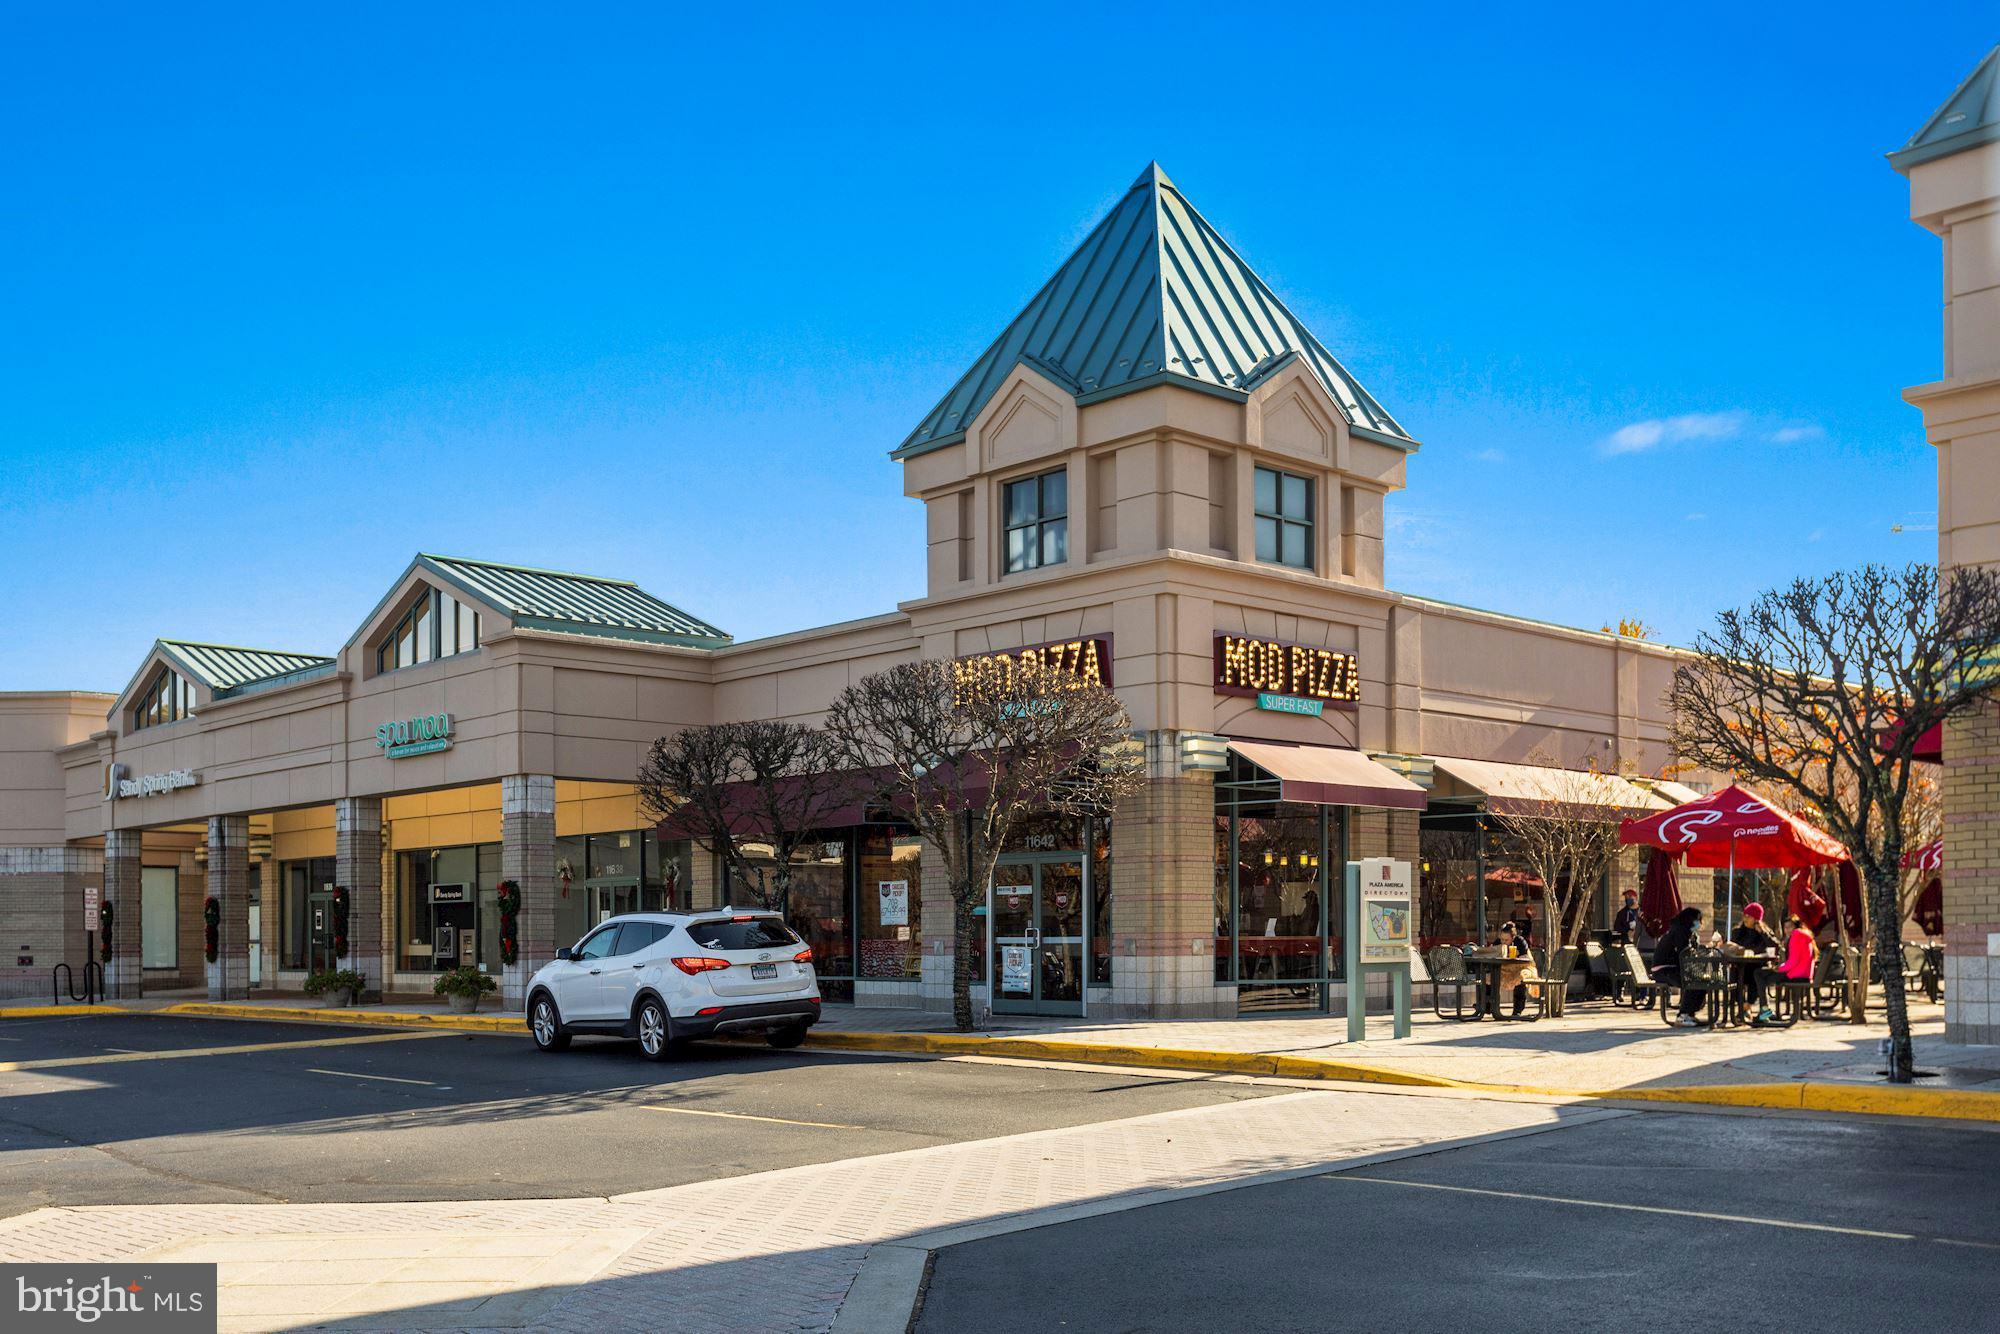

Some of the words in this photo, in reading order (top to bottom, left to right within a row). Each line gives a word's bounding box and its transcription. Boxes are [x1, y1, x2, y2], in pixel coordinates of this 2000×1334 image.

[1225, 636, 1284, 690] MOD
[1292, 646, 1360, 701] PIZZA
[1266, 695, 1295, 712] SUPER
[1297, 700, 1319, 714] FAST
[375, 720, 409, 759] spa
[413, 713, 449, 740] noa
[120, 779, 142, 798] Sandy
[144, 773, 168, 797] Spring
[169, 768, 192, 788] Bank
[1024, 834, 1055, 848] 11642
[1747, 825, 1779, 834] noodles
